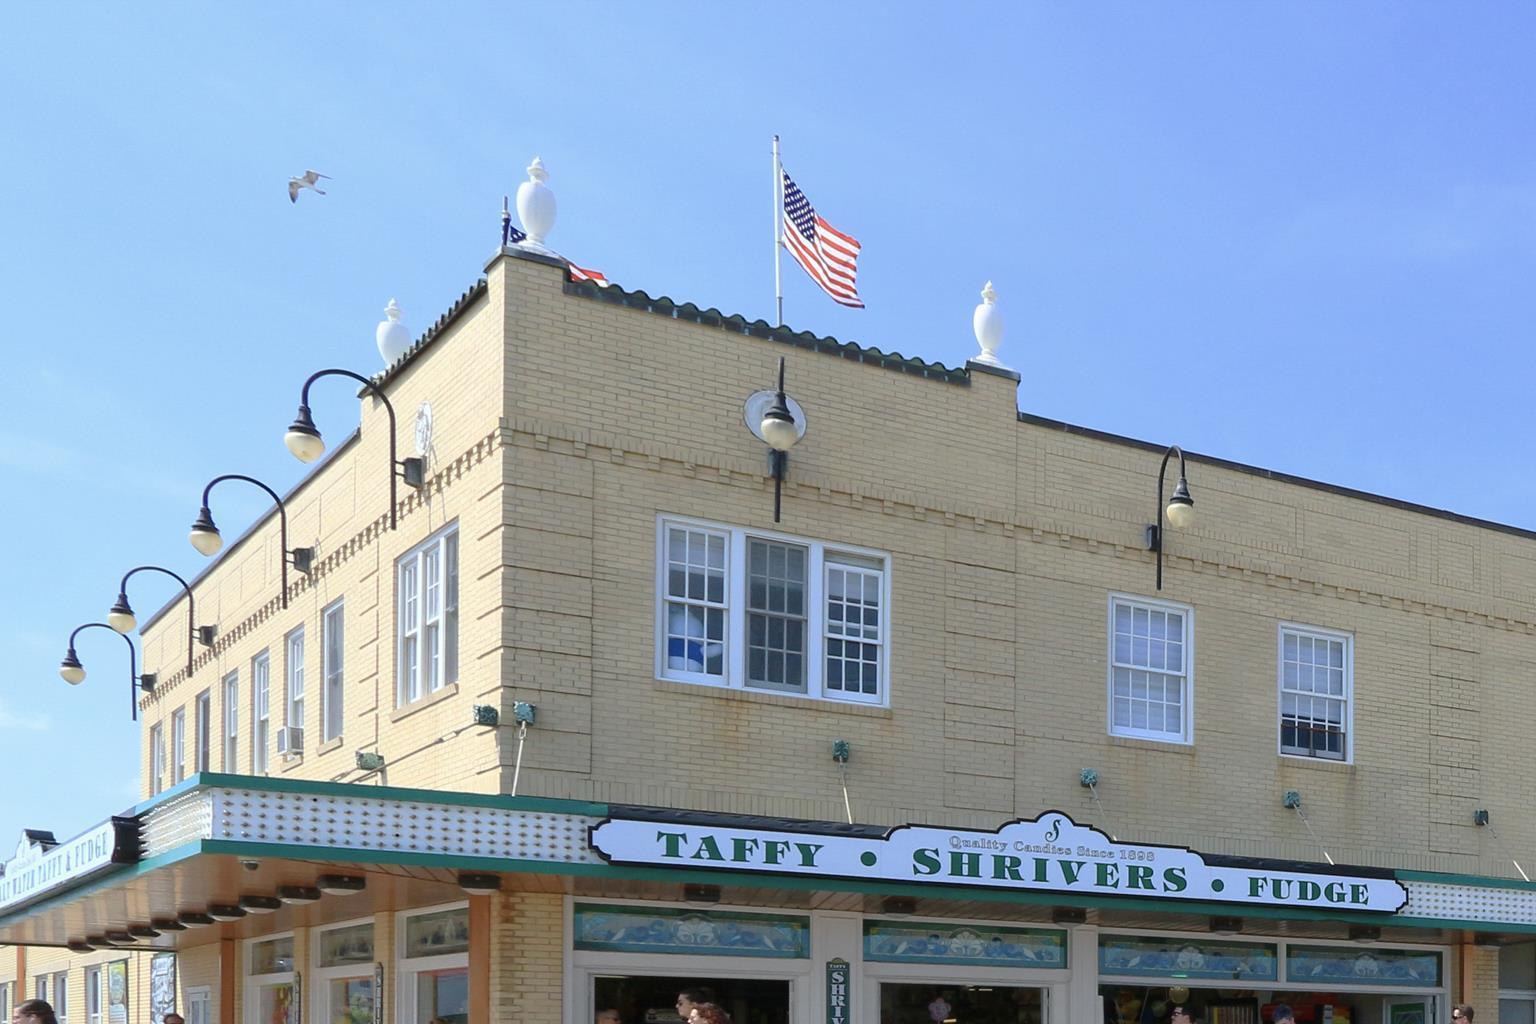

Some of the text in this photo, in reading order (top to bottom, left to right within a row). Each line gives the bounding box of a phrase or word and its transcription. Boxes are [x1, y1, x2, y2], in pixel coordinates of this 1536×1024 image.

[75, 831, 108, 868] FUDGE
[656, 831, 824, 867] TAFFY
[949, 836, 1008, 852] Quality
[1013, 841, 1072, 856] Candies
[1076, 846, 1116, 859] Since
[912, 847, 1188, 893] SHRIVERS
[1247, 876, 1370, 906] FUDGE
